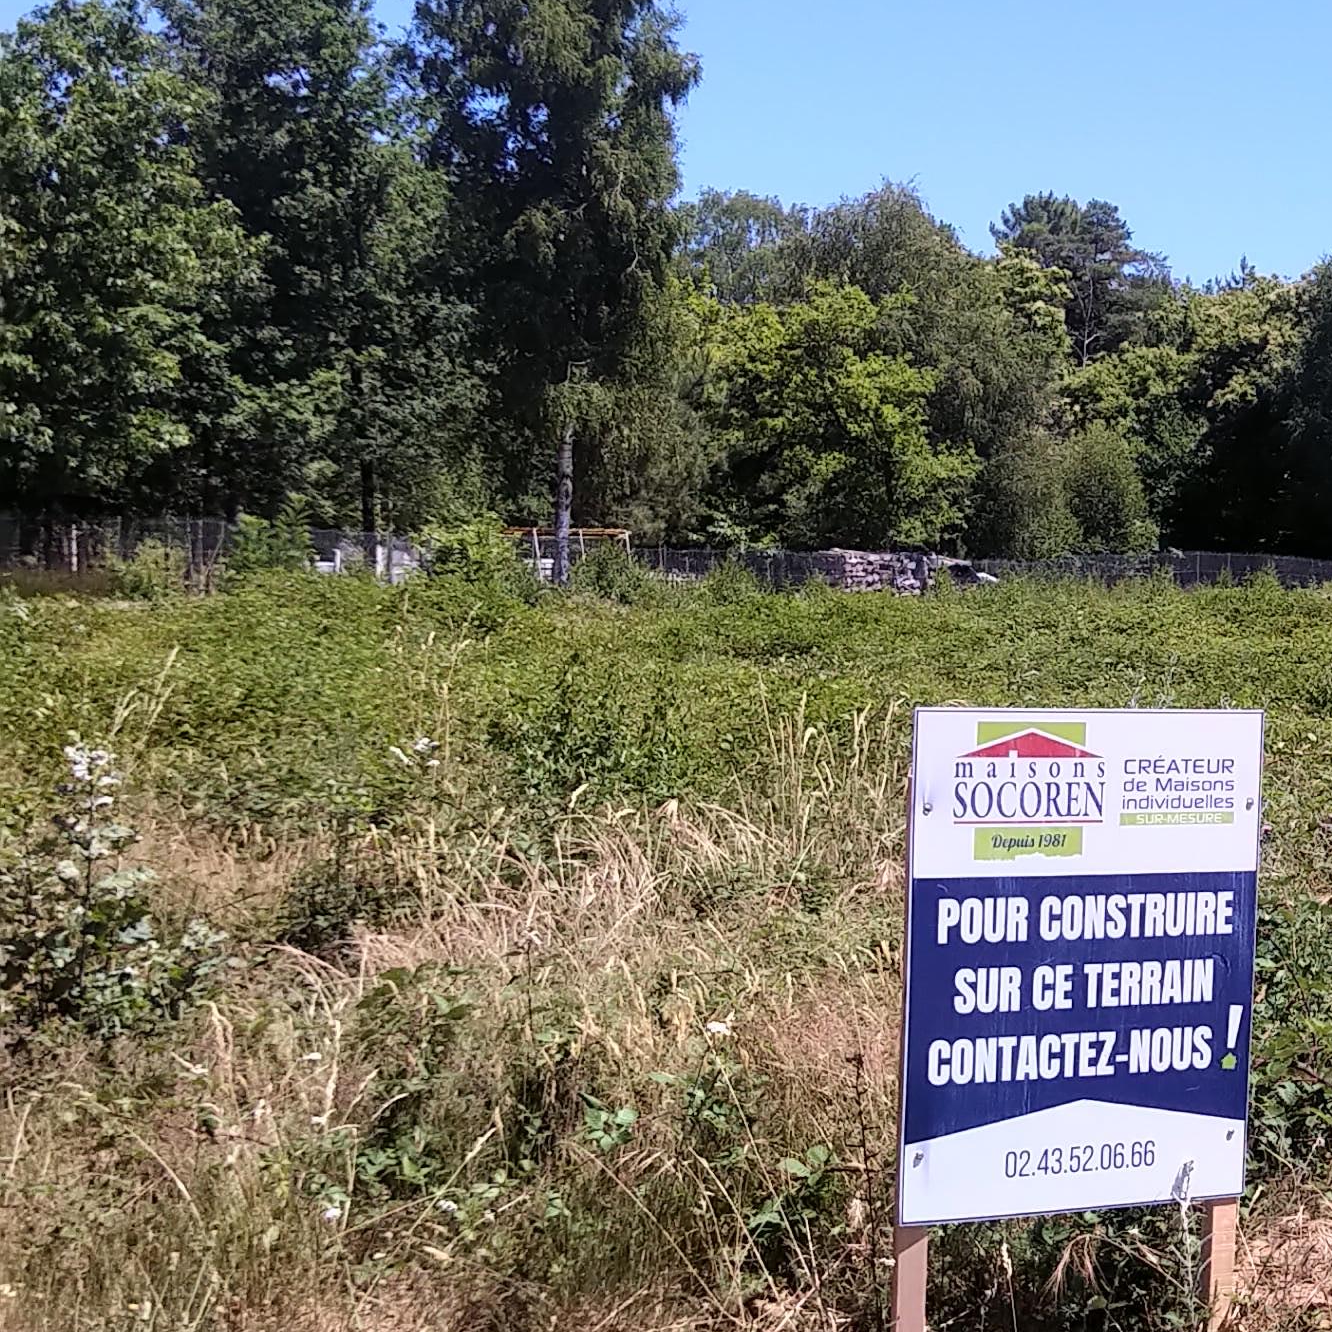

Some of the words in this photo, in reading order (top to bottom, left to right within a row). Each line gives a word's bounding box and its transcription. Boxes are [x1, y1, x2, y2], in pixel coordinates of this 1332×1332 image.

[953, 760, 1106, 778] maisons
[1123, 754, 1235, 775] CRÉATEUR
[1123, 777, 1148, 793] de
[1155, 776, 1235, 792] Maisons
[952, 780, 1106, 819] SOCOREN
[1121, 794, 1235, 810] individuelles
[1135, 812, 1223, 825] SUR-MESURE
[991, 833, 1035, 852] Depuis
[1037, 833, 1067, 849] 1981
[937, 896, 1029, 944] POUR
[1039, 891, 1234, 941] CONSTRUIRE
[954, 966, 1022, 1014] SUR
[1032, 964, 1074, 1010] CE
[1083, 958, 1214, 1008] TERRAIN
[927, 1025, 1213, 1086] CONTACTEZ-NOUS
[1004, 1140, 1156, 1178] 02.43.52.06.66
